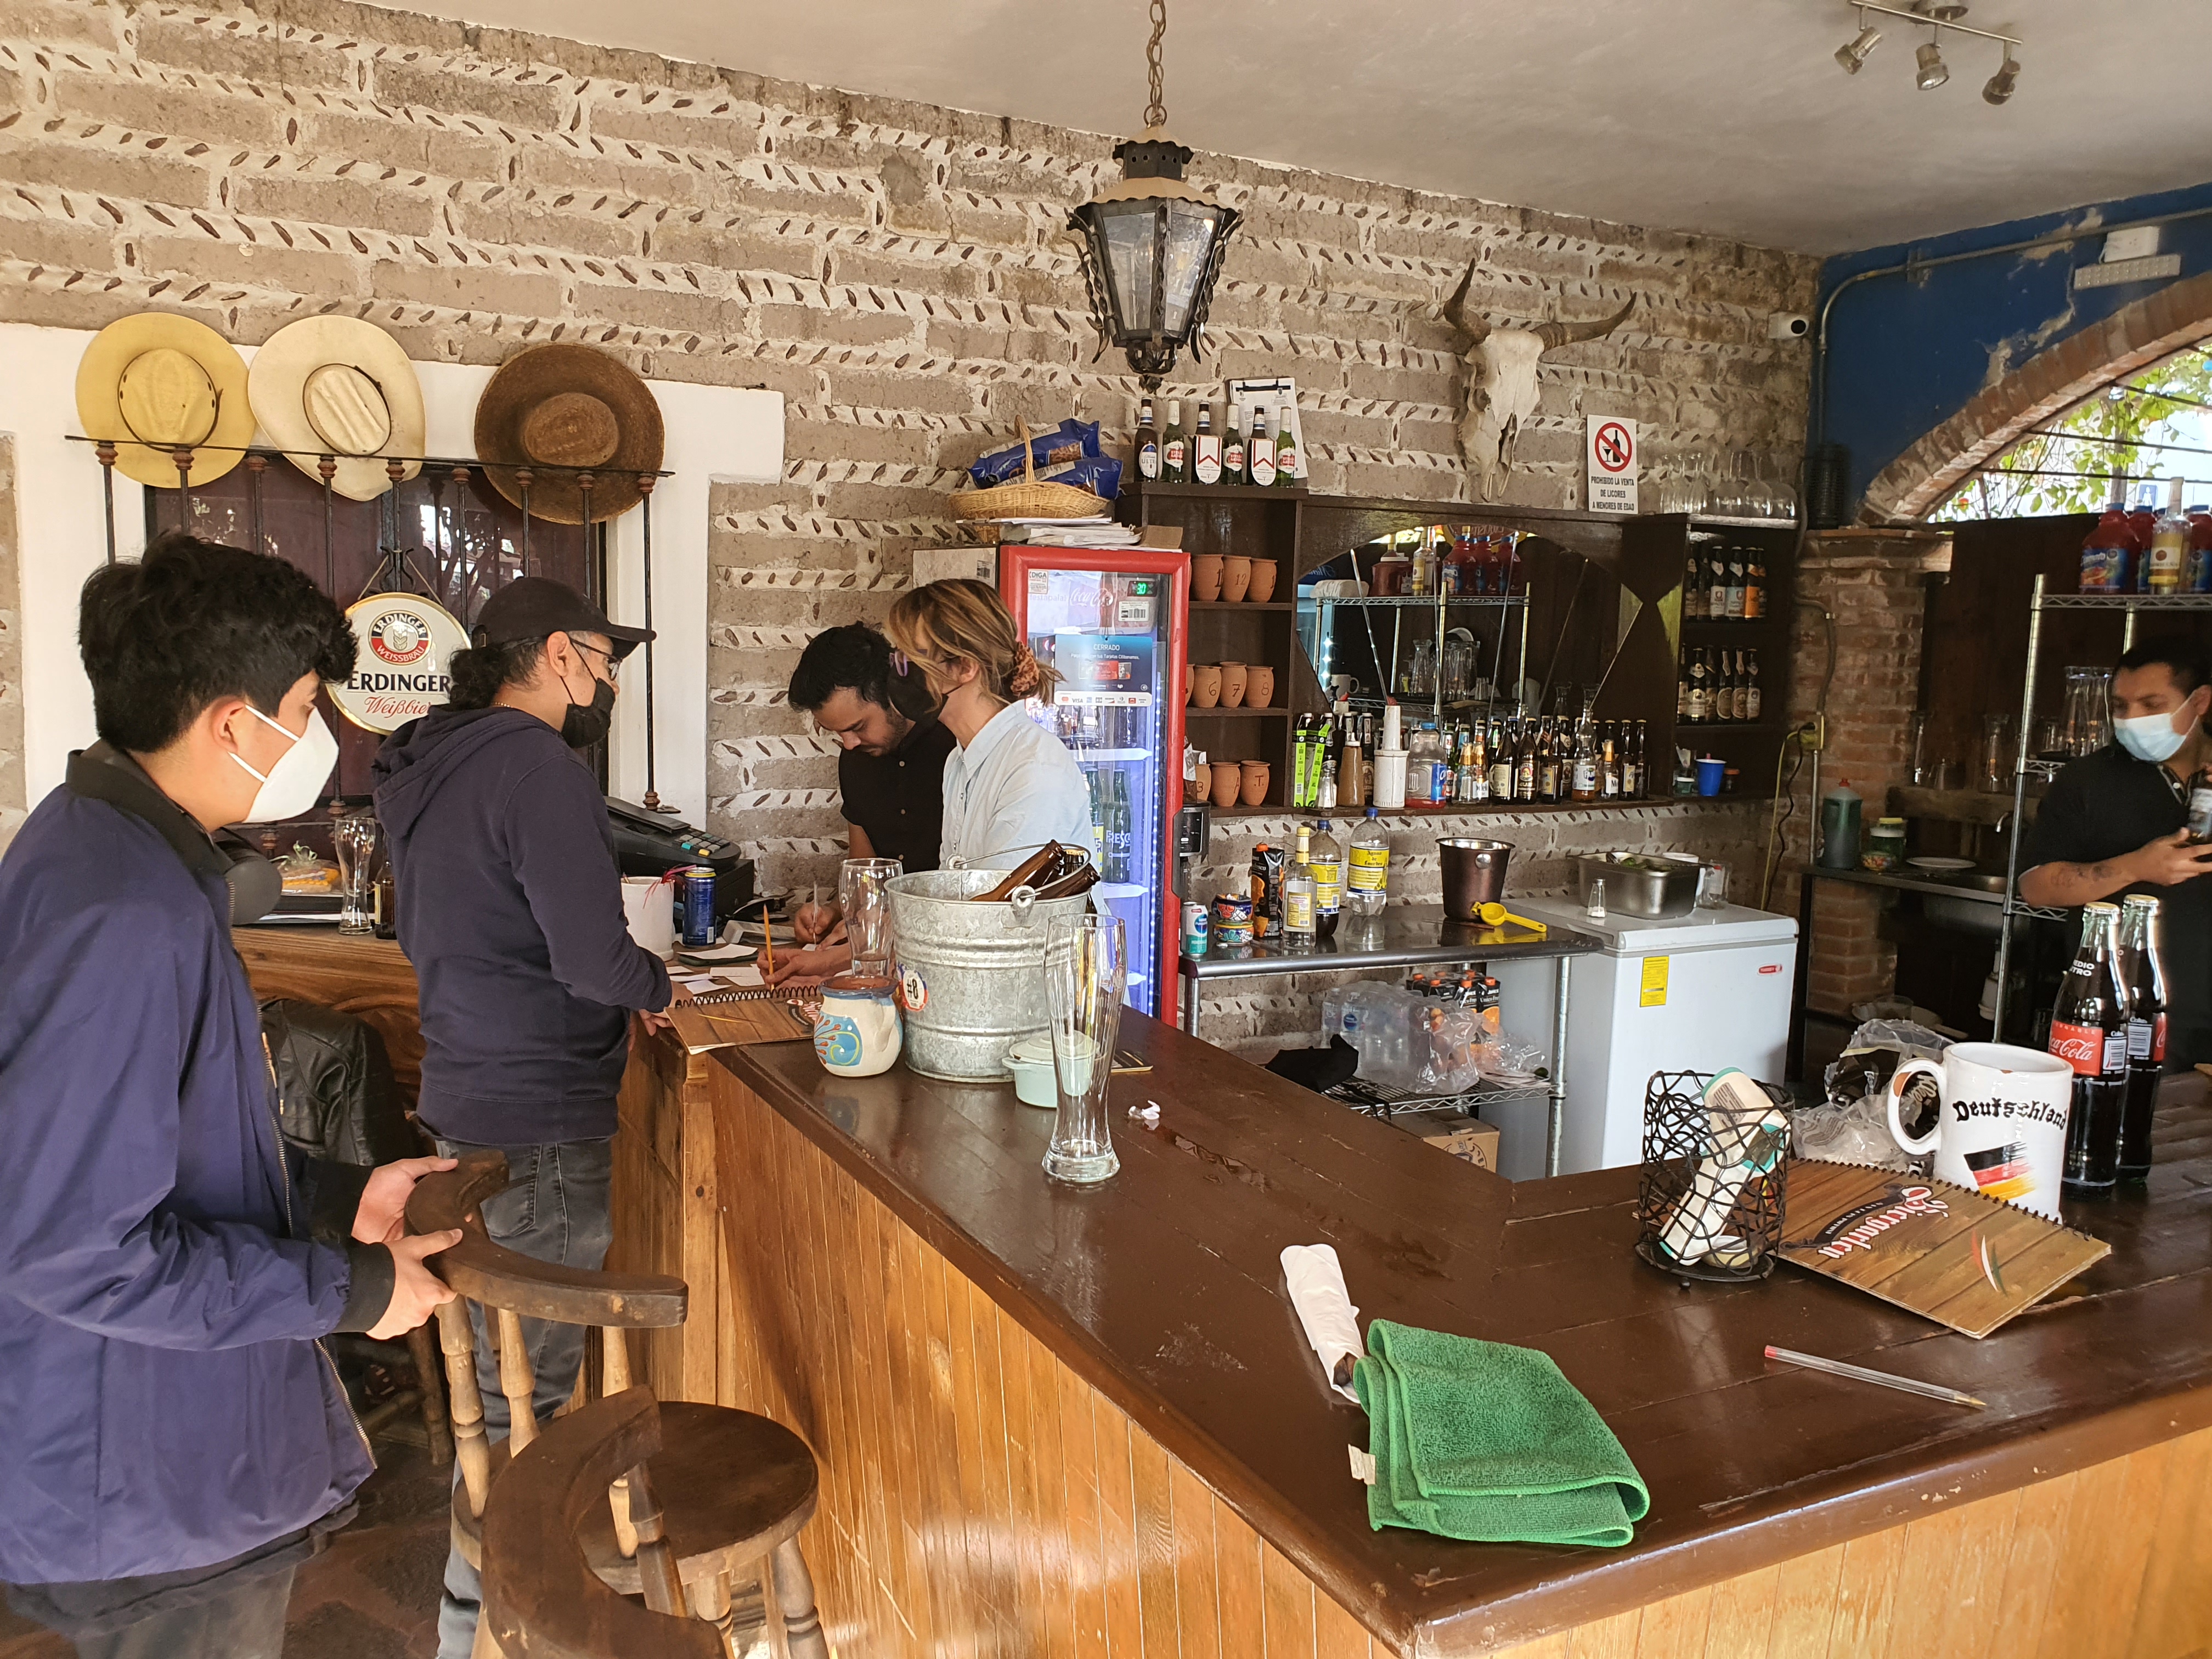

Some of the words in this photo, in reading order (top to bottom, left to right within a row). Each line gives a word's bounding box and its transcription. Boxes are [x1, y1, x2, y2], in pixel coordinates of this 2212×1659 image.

[1591, 476, 1613, 485] PROHIBIDO
[1615, 477, 1620, 486] LA
[1621, 478, 1634, 486] VENTA
[1600, 489, 1606, 497] DE
[1607, 489, 1626, 498] LICORES
[1596, 501, 1616, 510] MENORES
[1618, 502, 1623, 510] DE
[1623, 503, 1634, 511] EDAD
[1235, 573, 1246, 586] 12
[373, 614, 426, 635] ERDINGER
[347, 670, 450, 693] ERDINGER
[1209, 681, 1217, 696] 6
[1232, 684, 1240, 697] 7
[1261, 682, 1269, 696] 8
[1197, 781, 1204, 793] 3
[2073, 960, 2095, 970] EDIO
[906, 978, 919, 1000] #8
[1953, 1098, 2068, 1131] Deutschland
[1818, 1186, 1949, 1259] Biergarten
